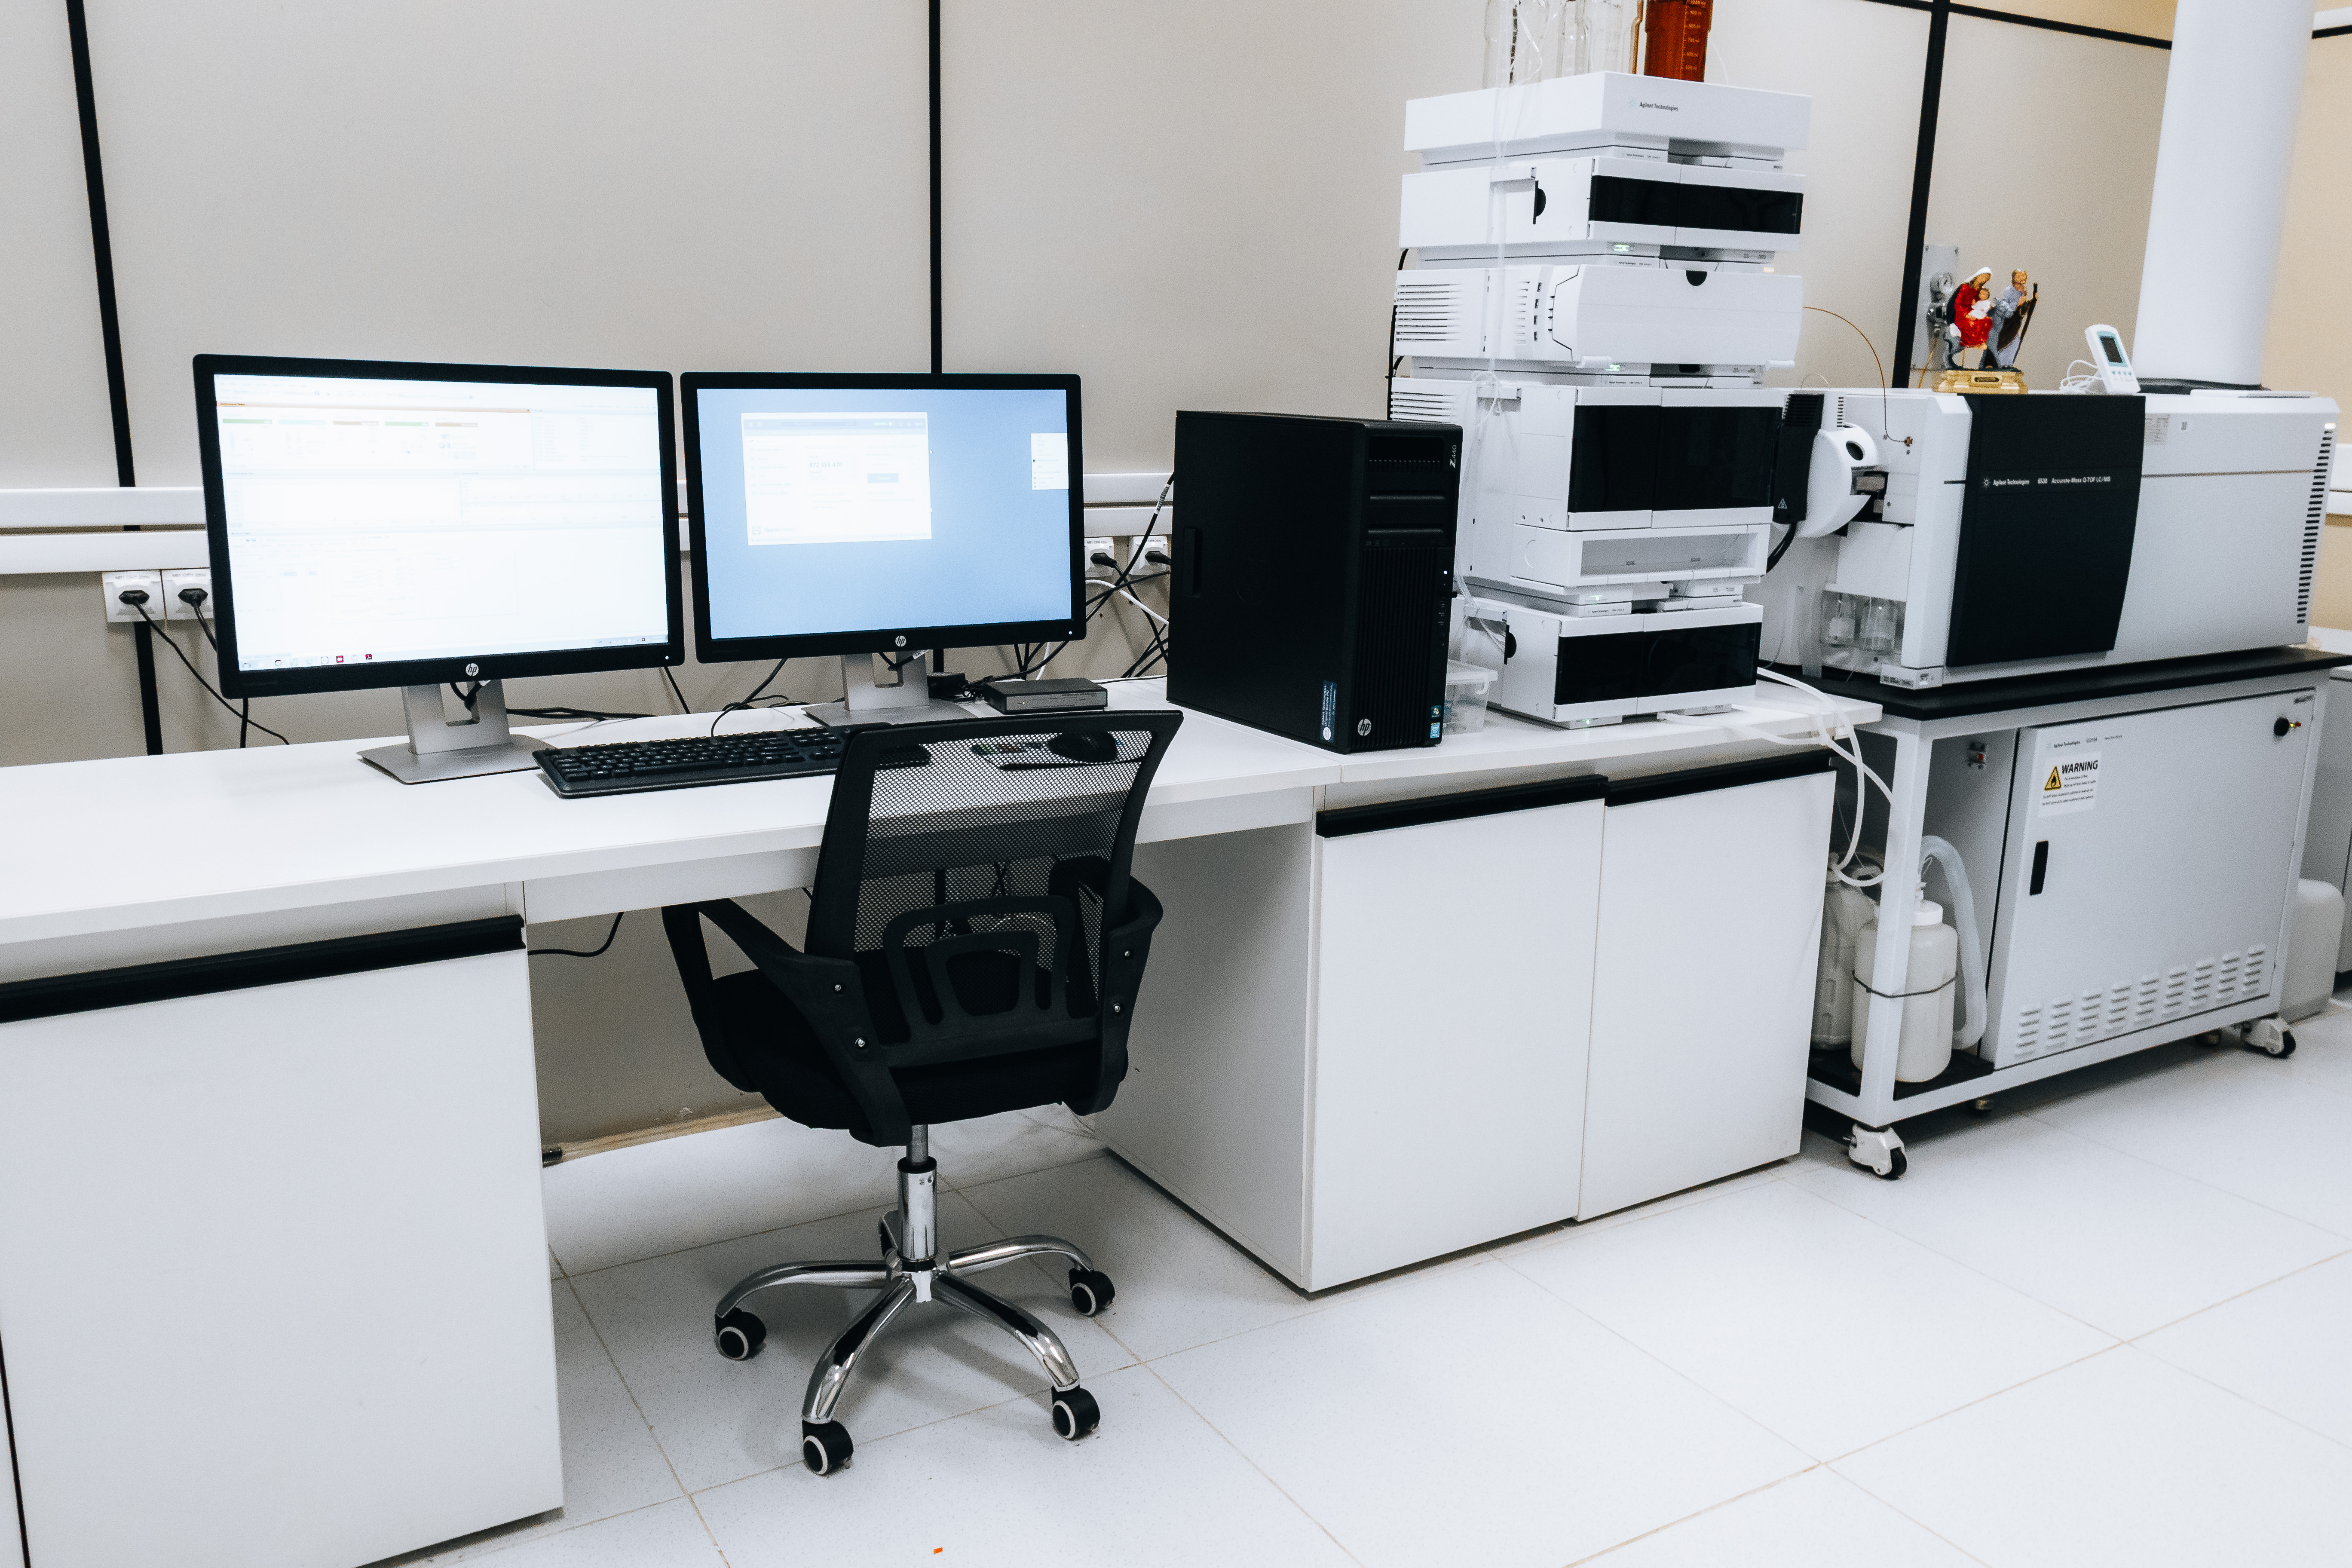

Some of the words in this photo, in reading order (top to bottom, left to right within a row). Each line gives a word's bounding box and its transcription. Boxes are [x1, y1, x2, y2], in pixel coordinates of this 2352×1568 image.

[1654, 103, 1678, 111] Technologies
[896, 636, 906, 646] hp
[466, 663, 478, 676] hp
[1358, 719, 1371, 736] hp
[2062, 760, 2098, 774] WARNING
